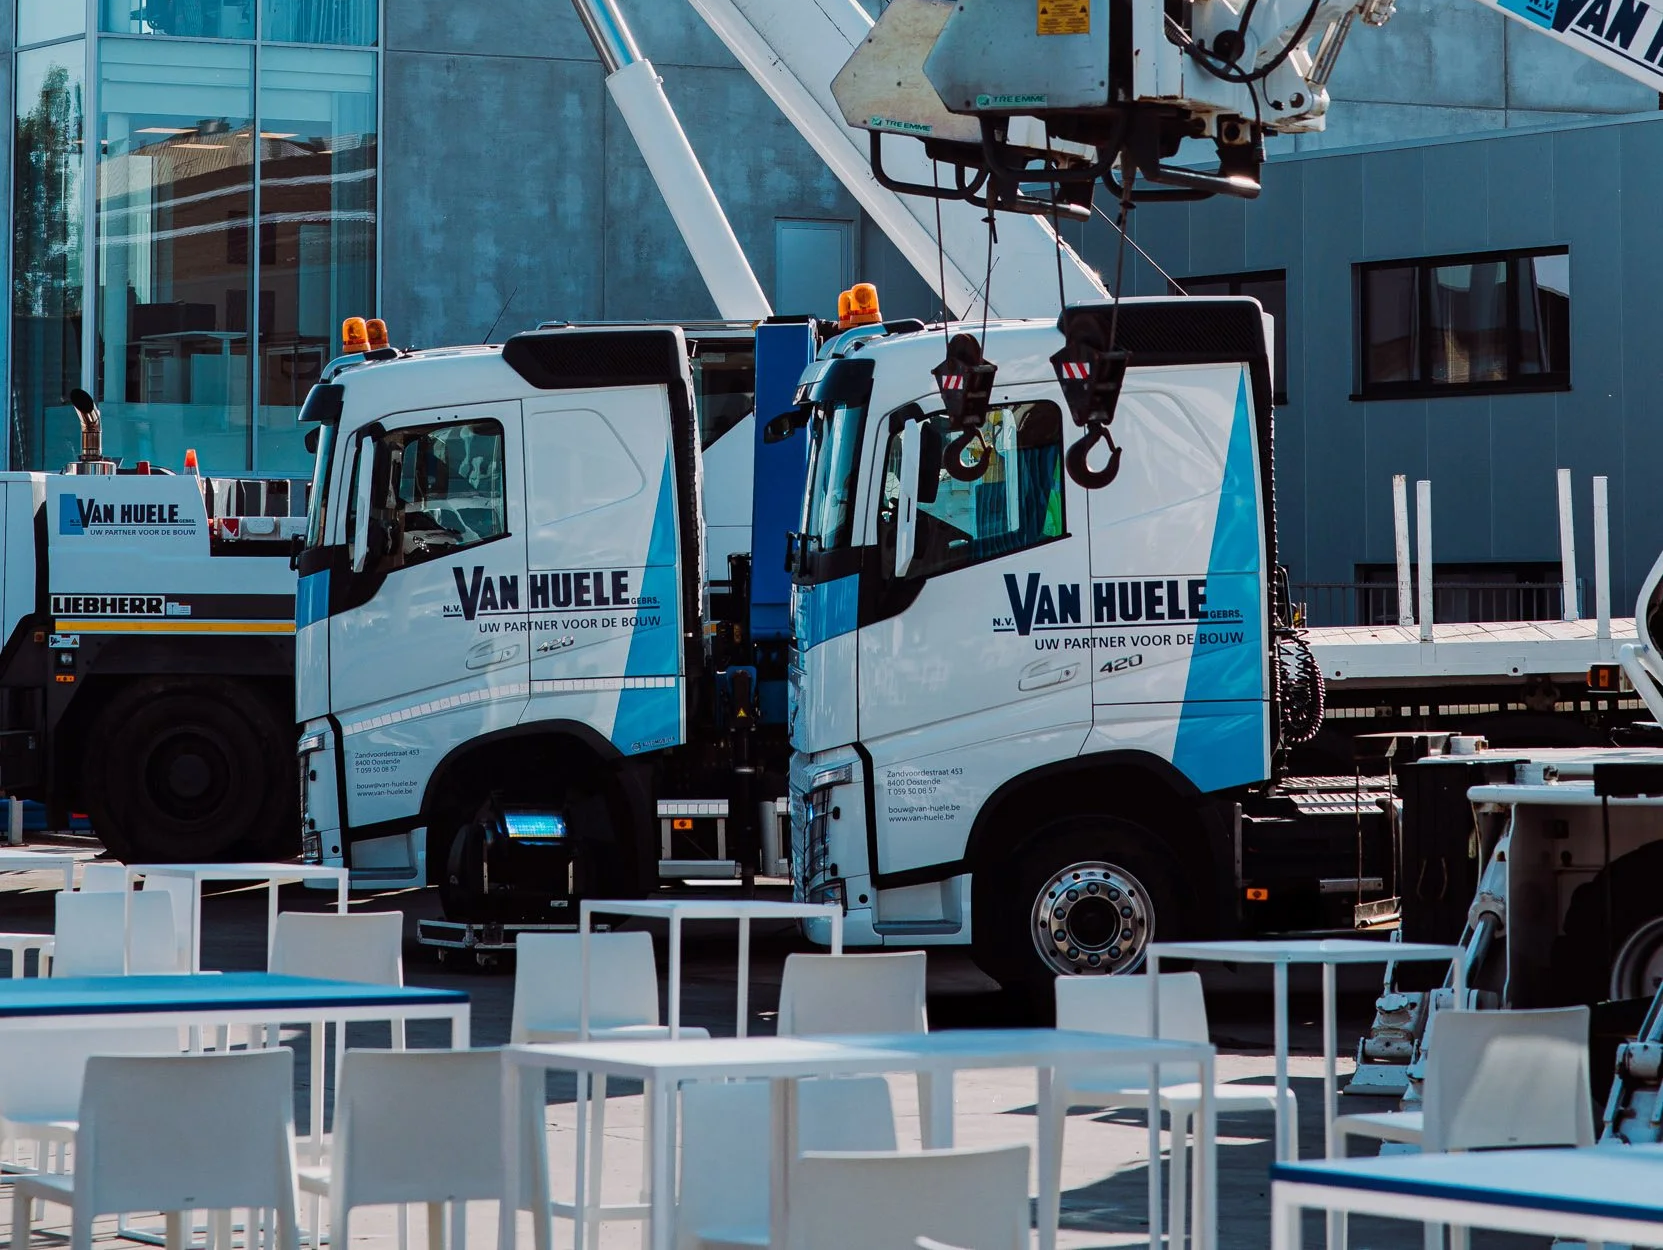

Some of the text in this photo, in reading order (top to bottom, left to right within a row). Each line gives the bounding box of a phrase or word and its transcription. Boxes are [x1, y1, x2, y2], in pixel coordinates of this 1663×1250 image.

[76, 498, 114, 528] VAN
[120, 504, 179, 523] HUELE
[442, 566, 660, 620] N.V. VAN HUELE GEBRS.
[52, 597, 162, 614] LIEBHERR
[992, 572, 1243, 636] N.V. VAN HUELE GEBRS.
[479, 616, 661, 633] UW PARTNER VOOR DE BOUW
[536, 636, 575, 653] 420
[1034, 632, 1244, 650] UW PARTNER VOOR DE BOUW
[1100, 653, 1143, 673] 420
[355, 748, 420, 759] Zandvoordestraat 453
[371, 758, 401, 766] Oostende
[887, 767, 963, 778] Zandvoordestraat 453
[887, 778, 941, 787] 8400 Oostende
[928, 786, 937, 794] 57
[888, 804, 961, 814] bouw@van-huele.be
[889, 813, 955, 823] www.van-huele.be
